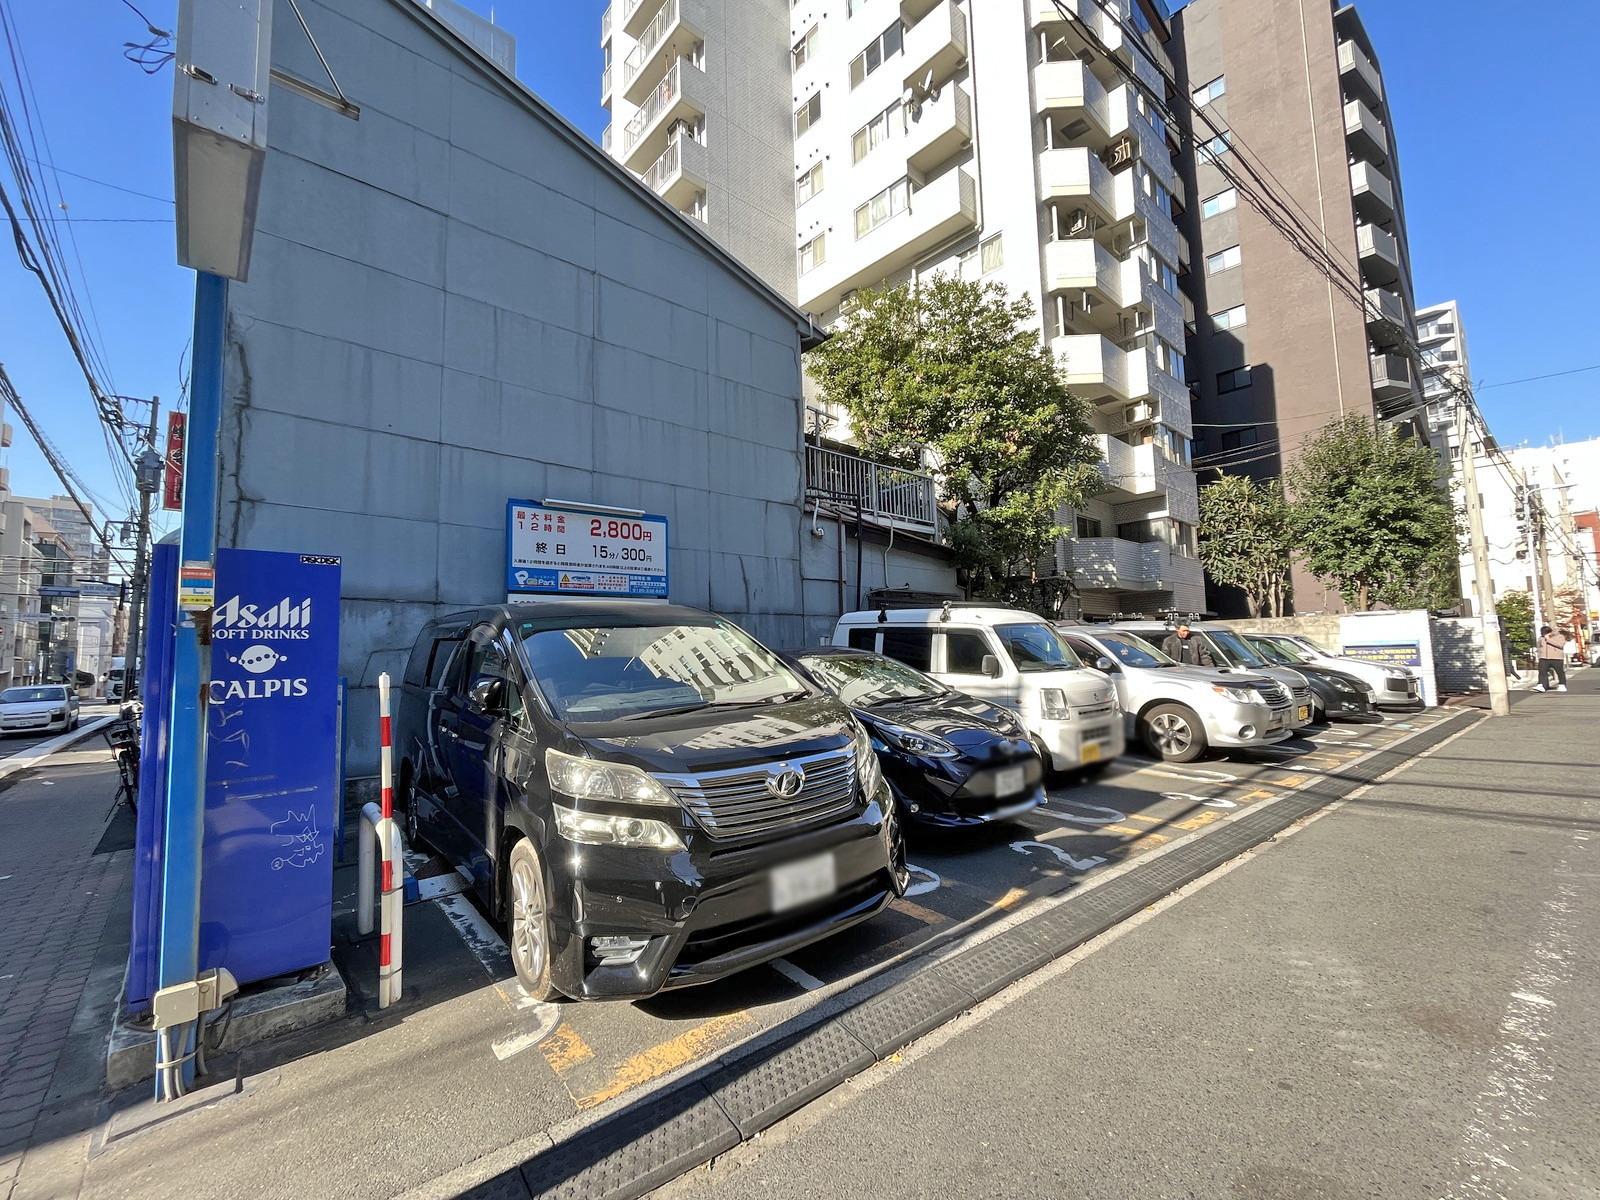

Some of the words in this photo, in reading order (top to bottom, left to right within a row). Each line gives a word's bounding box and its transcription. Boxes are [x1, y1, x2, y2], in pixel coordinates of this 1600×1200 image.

[516, 510, 566, 524] 最大料金
[518, 520, 566, 534] 12時間
[590, 519, 652, 542] 2,800円
[535, 541, 566, 556] 終日
[211, 594, 311, 629] Asahi
[251, 629, 310, 640] DRINKS
[208, 678, 308, 705] CALPIS
